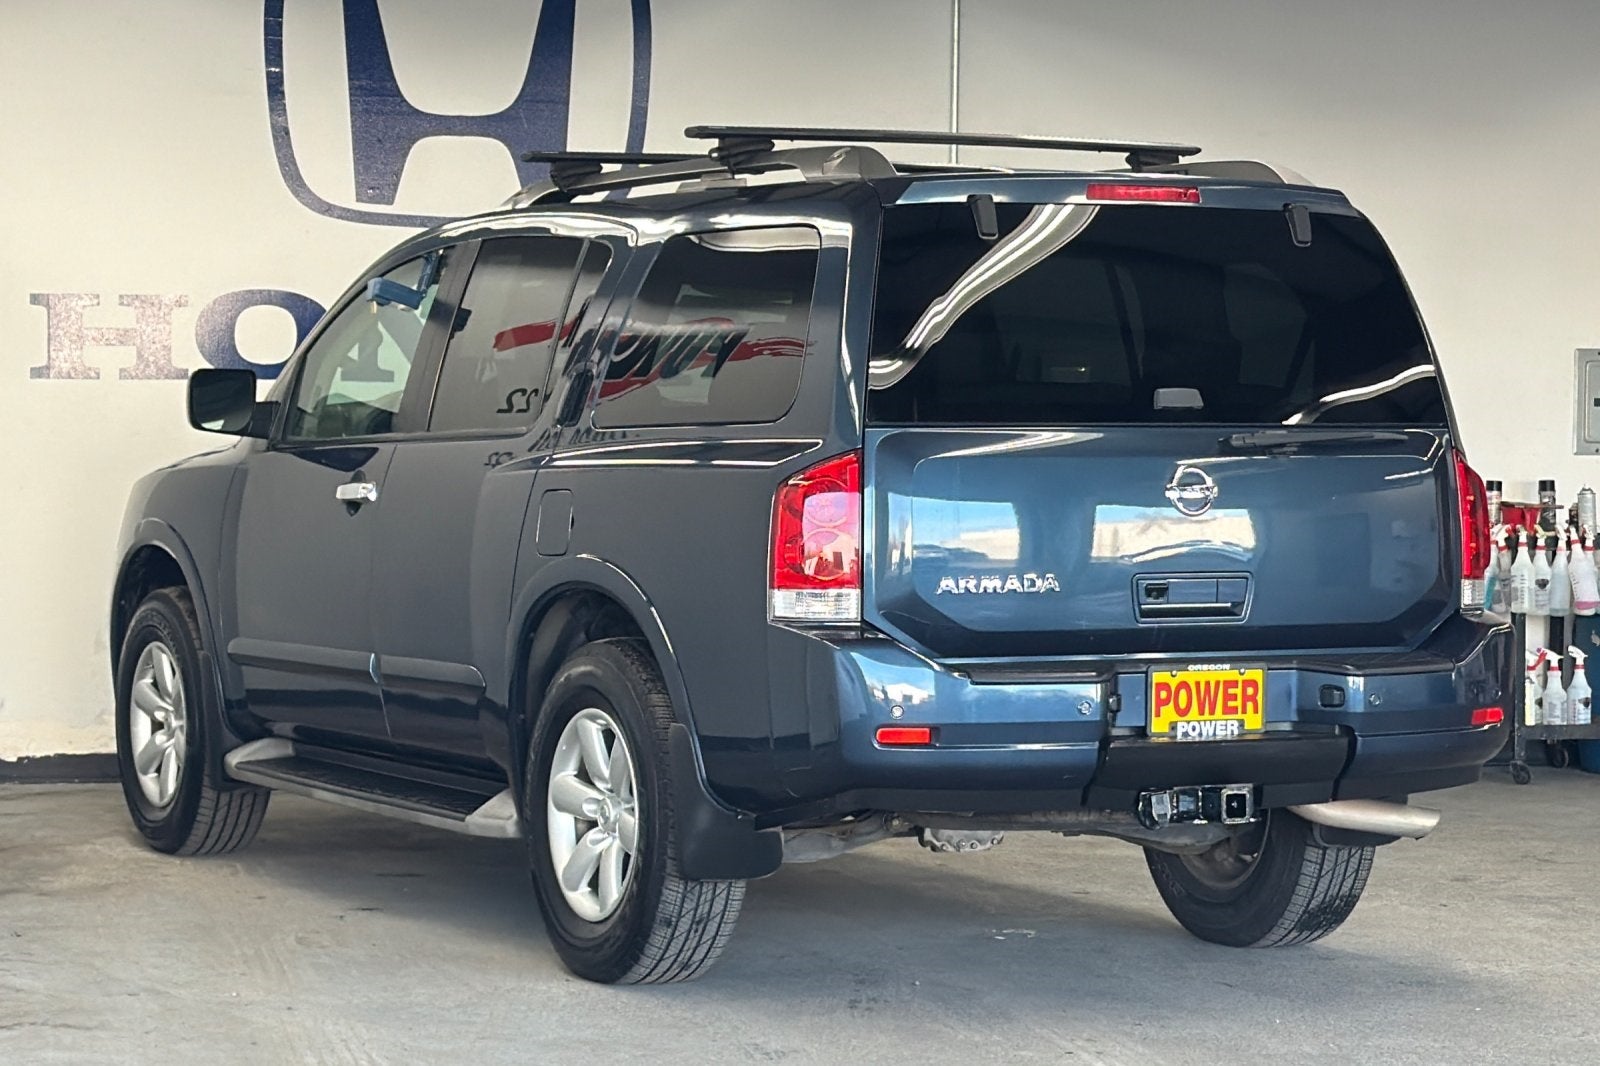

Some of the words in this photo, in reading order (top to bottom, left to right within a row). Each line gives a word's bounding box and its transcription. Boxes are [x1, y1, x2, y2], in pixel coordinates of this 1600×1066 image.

[936, 572, 1062, 595] ARMADA
[1187, 663, 1231, 671] OREGON
[1154, 679, 1259, 717] POWER
[1176, 719, 1239, 738] POWER
